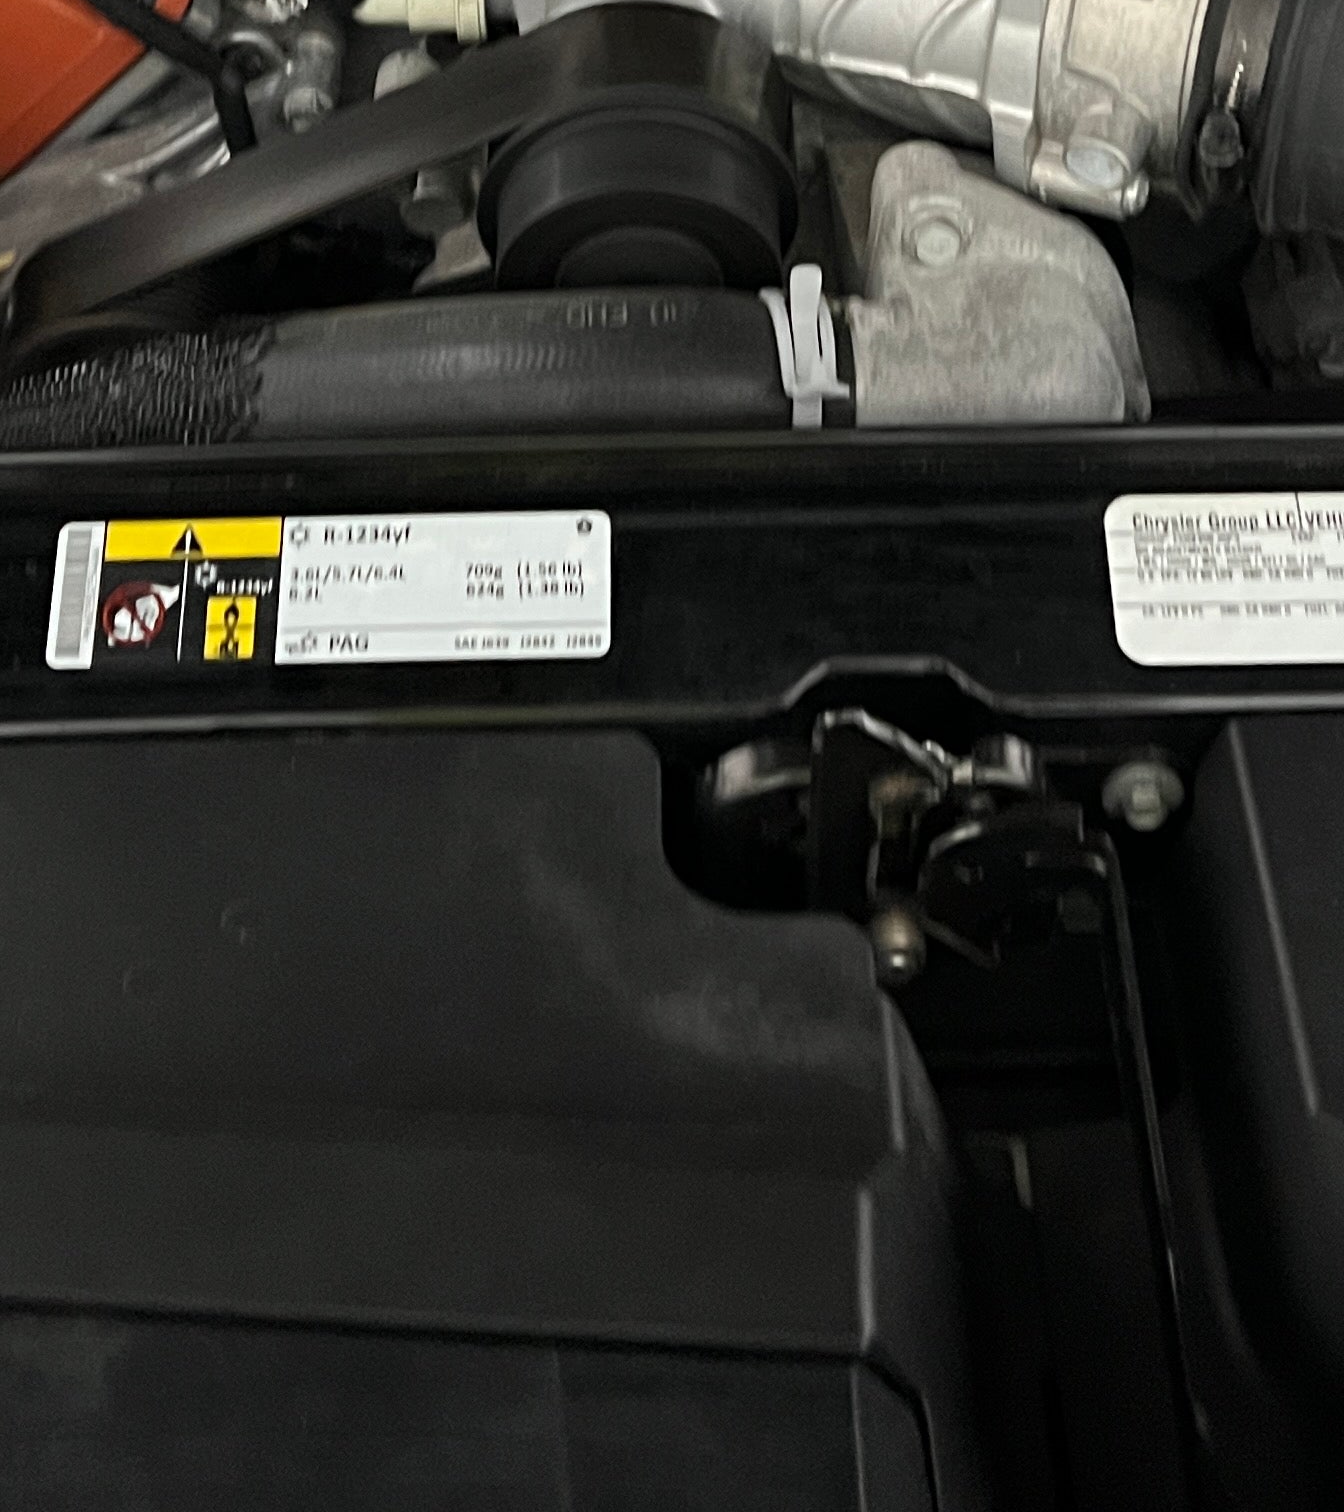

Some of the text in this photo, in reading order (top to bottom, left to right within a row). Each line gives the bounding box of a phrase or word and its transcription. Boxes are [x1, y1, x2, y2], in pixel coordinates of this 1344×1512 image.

[1132, 510, 1199, 533] Chrysler
[1208, 510, 1258, 531] Group
[1265, 510, 1296, 529] LLC
[328, 631, 370, 653] PAG
